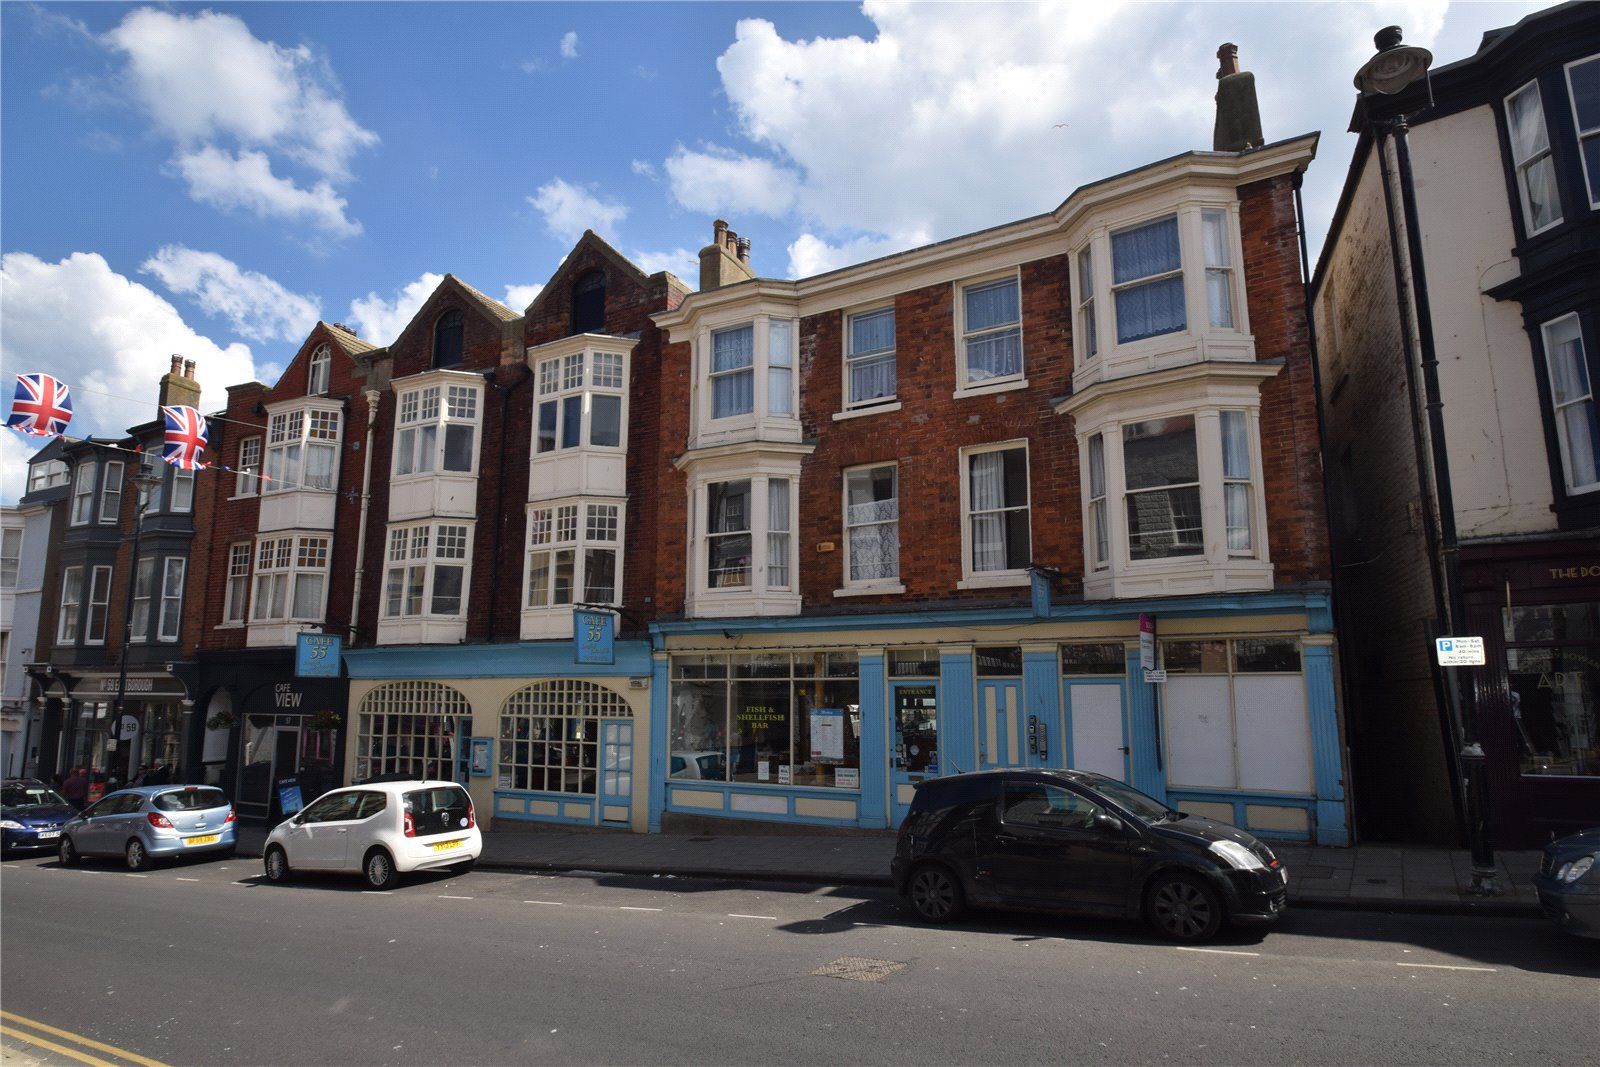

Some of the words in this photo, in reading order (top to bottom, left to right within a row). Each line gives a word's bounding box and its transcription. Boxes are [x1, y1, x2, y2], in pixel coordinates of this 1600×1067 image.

[1549, 567, 1578, 579] THE
[582, 615, 607, 625] CAFE
[587, 626, 602, 642] 55
[305, 637, 334, 646] CAFE
[1442, 641, 1451, 651] P
[310, 646, 327, 660] 55
[115, 679, 153, 691] ETBOROUGH
[1537, 671, 1583, 689] ART
[275, 683, 292, 692] CAFE
[275, 692, 302, 707] VIEW
[126, 723, 137, 731] 59
